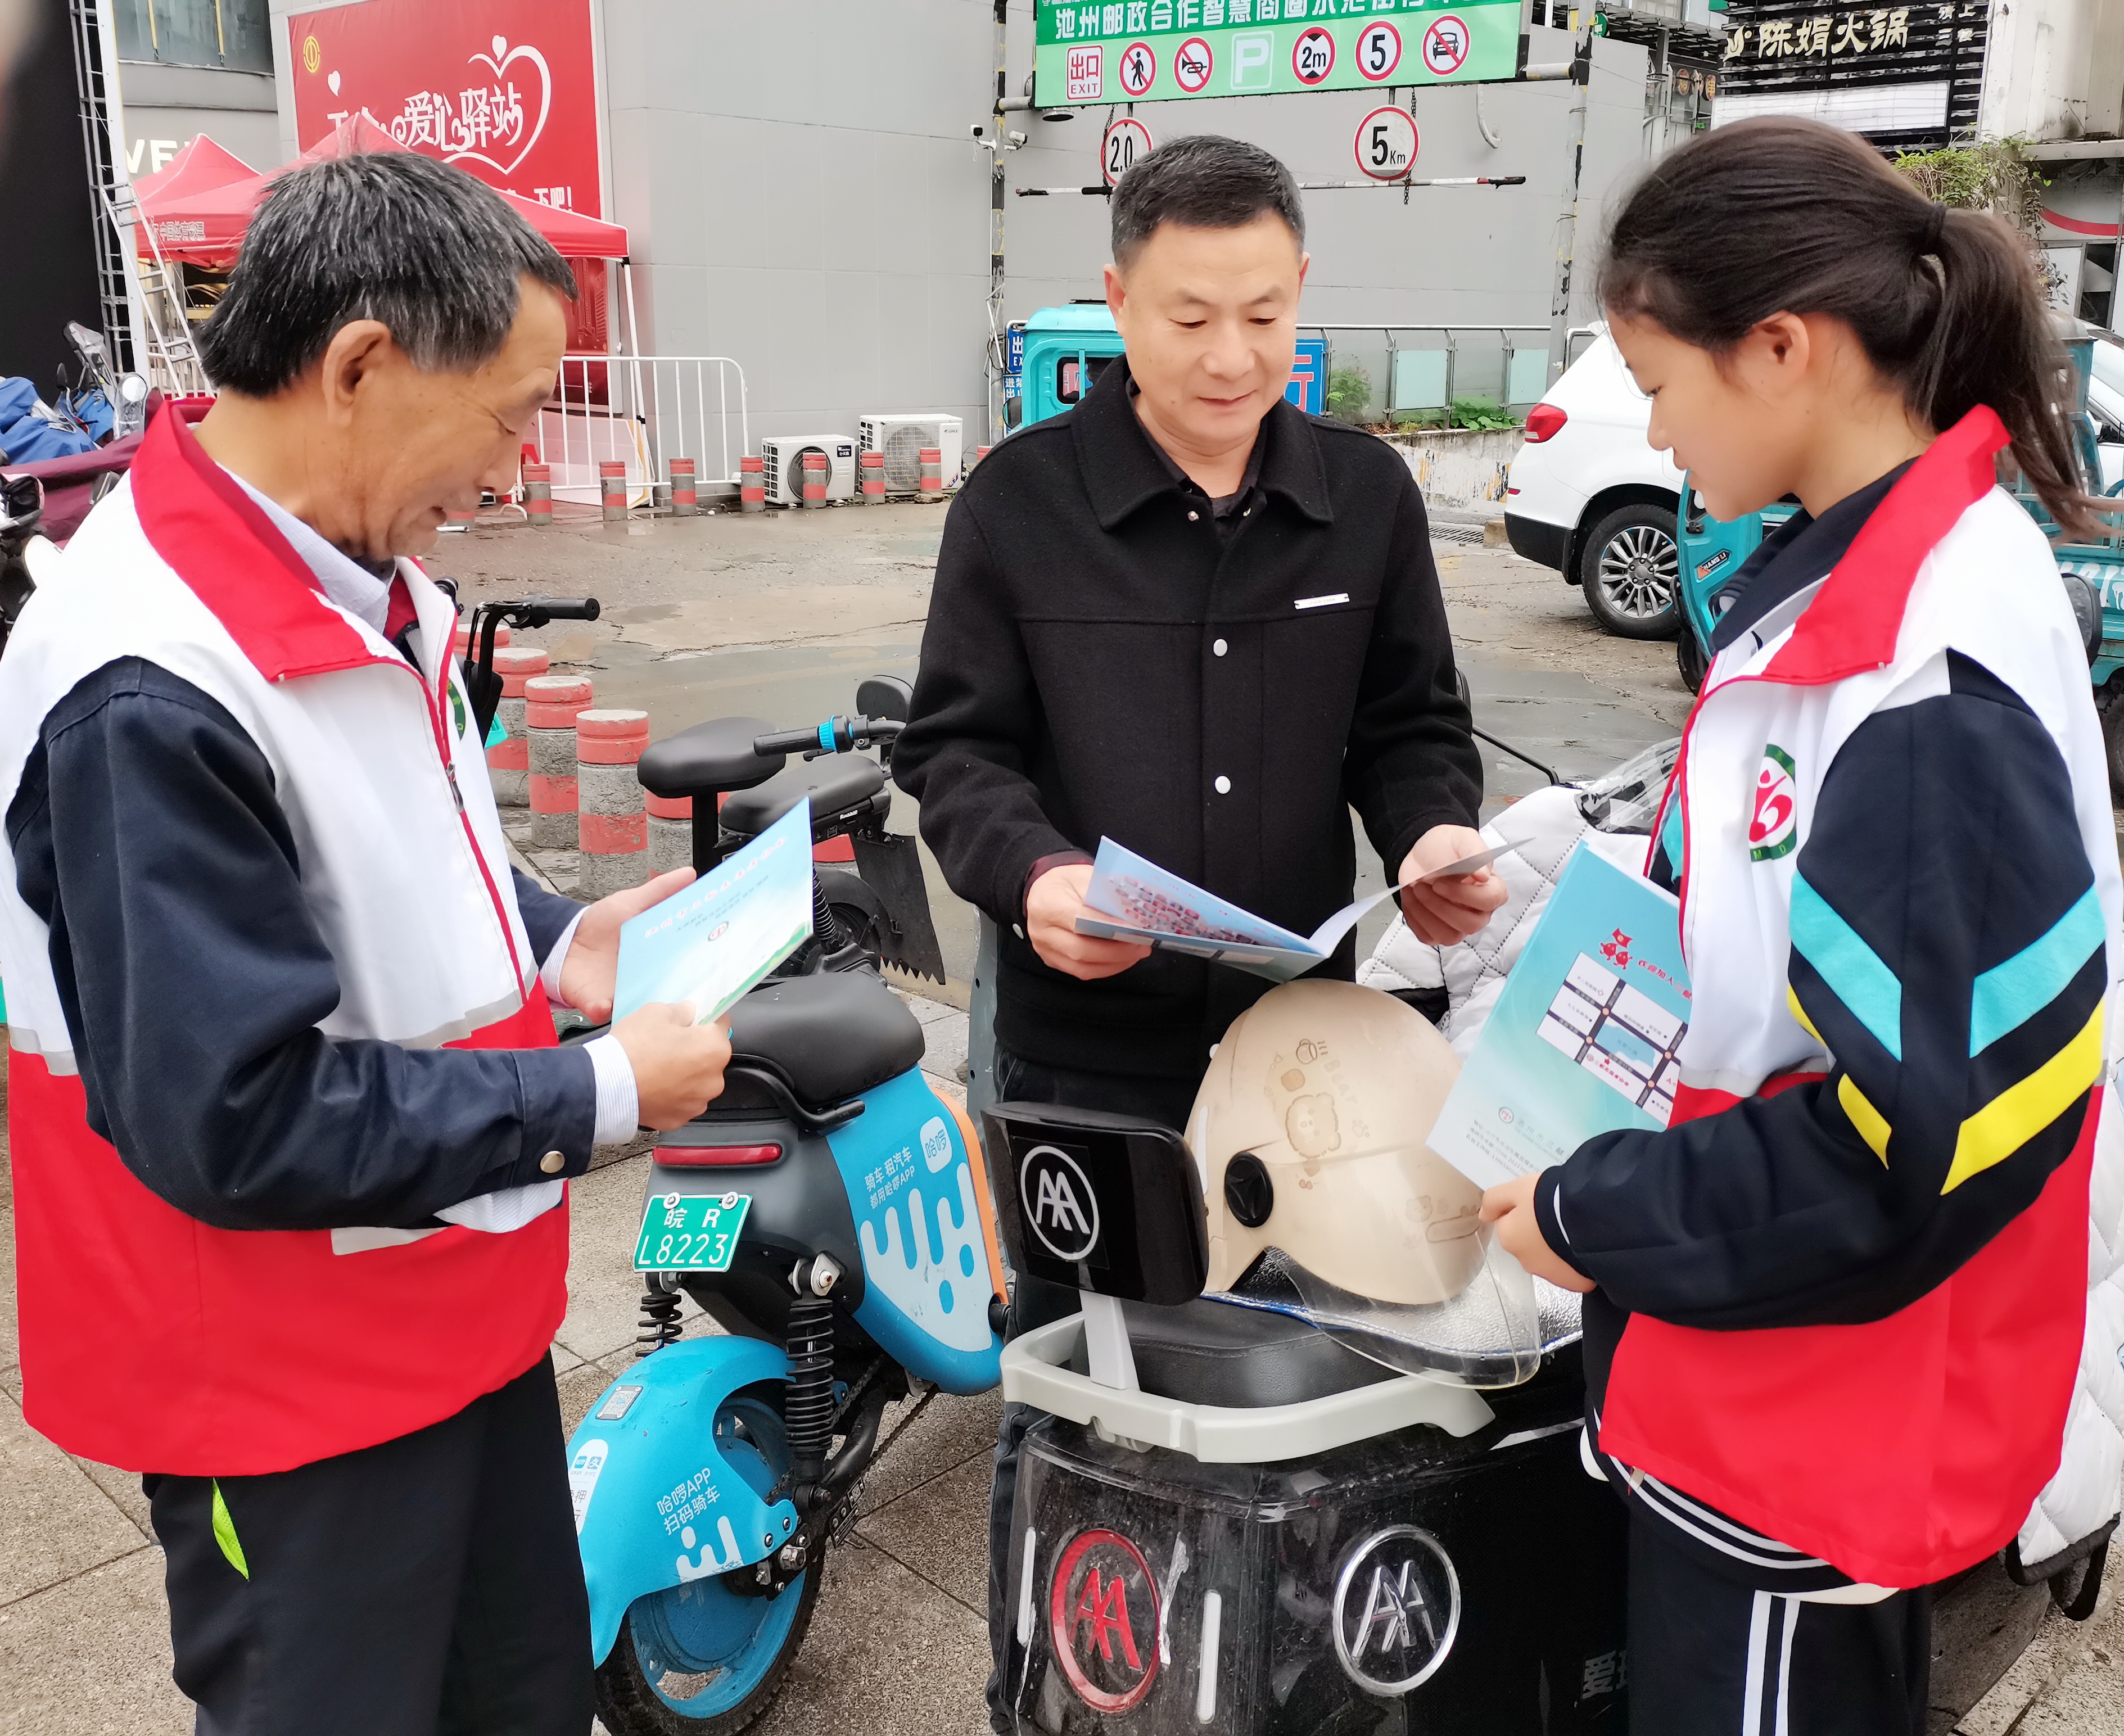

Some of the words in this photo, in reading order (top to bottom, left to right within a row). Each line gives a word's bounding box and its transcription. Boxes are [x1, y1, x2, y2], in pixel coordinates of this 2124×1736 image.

[1371, 34, 1386, 71] 5
[1759, 10, 1910, 58] 陈娟火锅
[1070, 53, 1099, 80] 出口
[1301, 46, 1326, 69] 2m
[1071, 83, 1099, 94] EXIT
[126, 139, 189, 174] VE
[1372, 126, 1388, 165] 5
[1390, 151, 1406, 164] Km
[865, 1167, 884, 1192] 骑车
[884, 1146, 912, 1177] 租汽车
[870, 1165, 915, 1209] 都用哈啰APP
[664, 1208, 688, 1229] 皖
[702, 1209, 721, 1228] R
[638, 1233, 729, 1265] L8223
[657, 1467, 711, 1515] 哈啰APP
[663, 1485, 720, 1535] 扫码骑车
